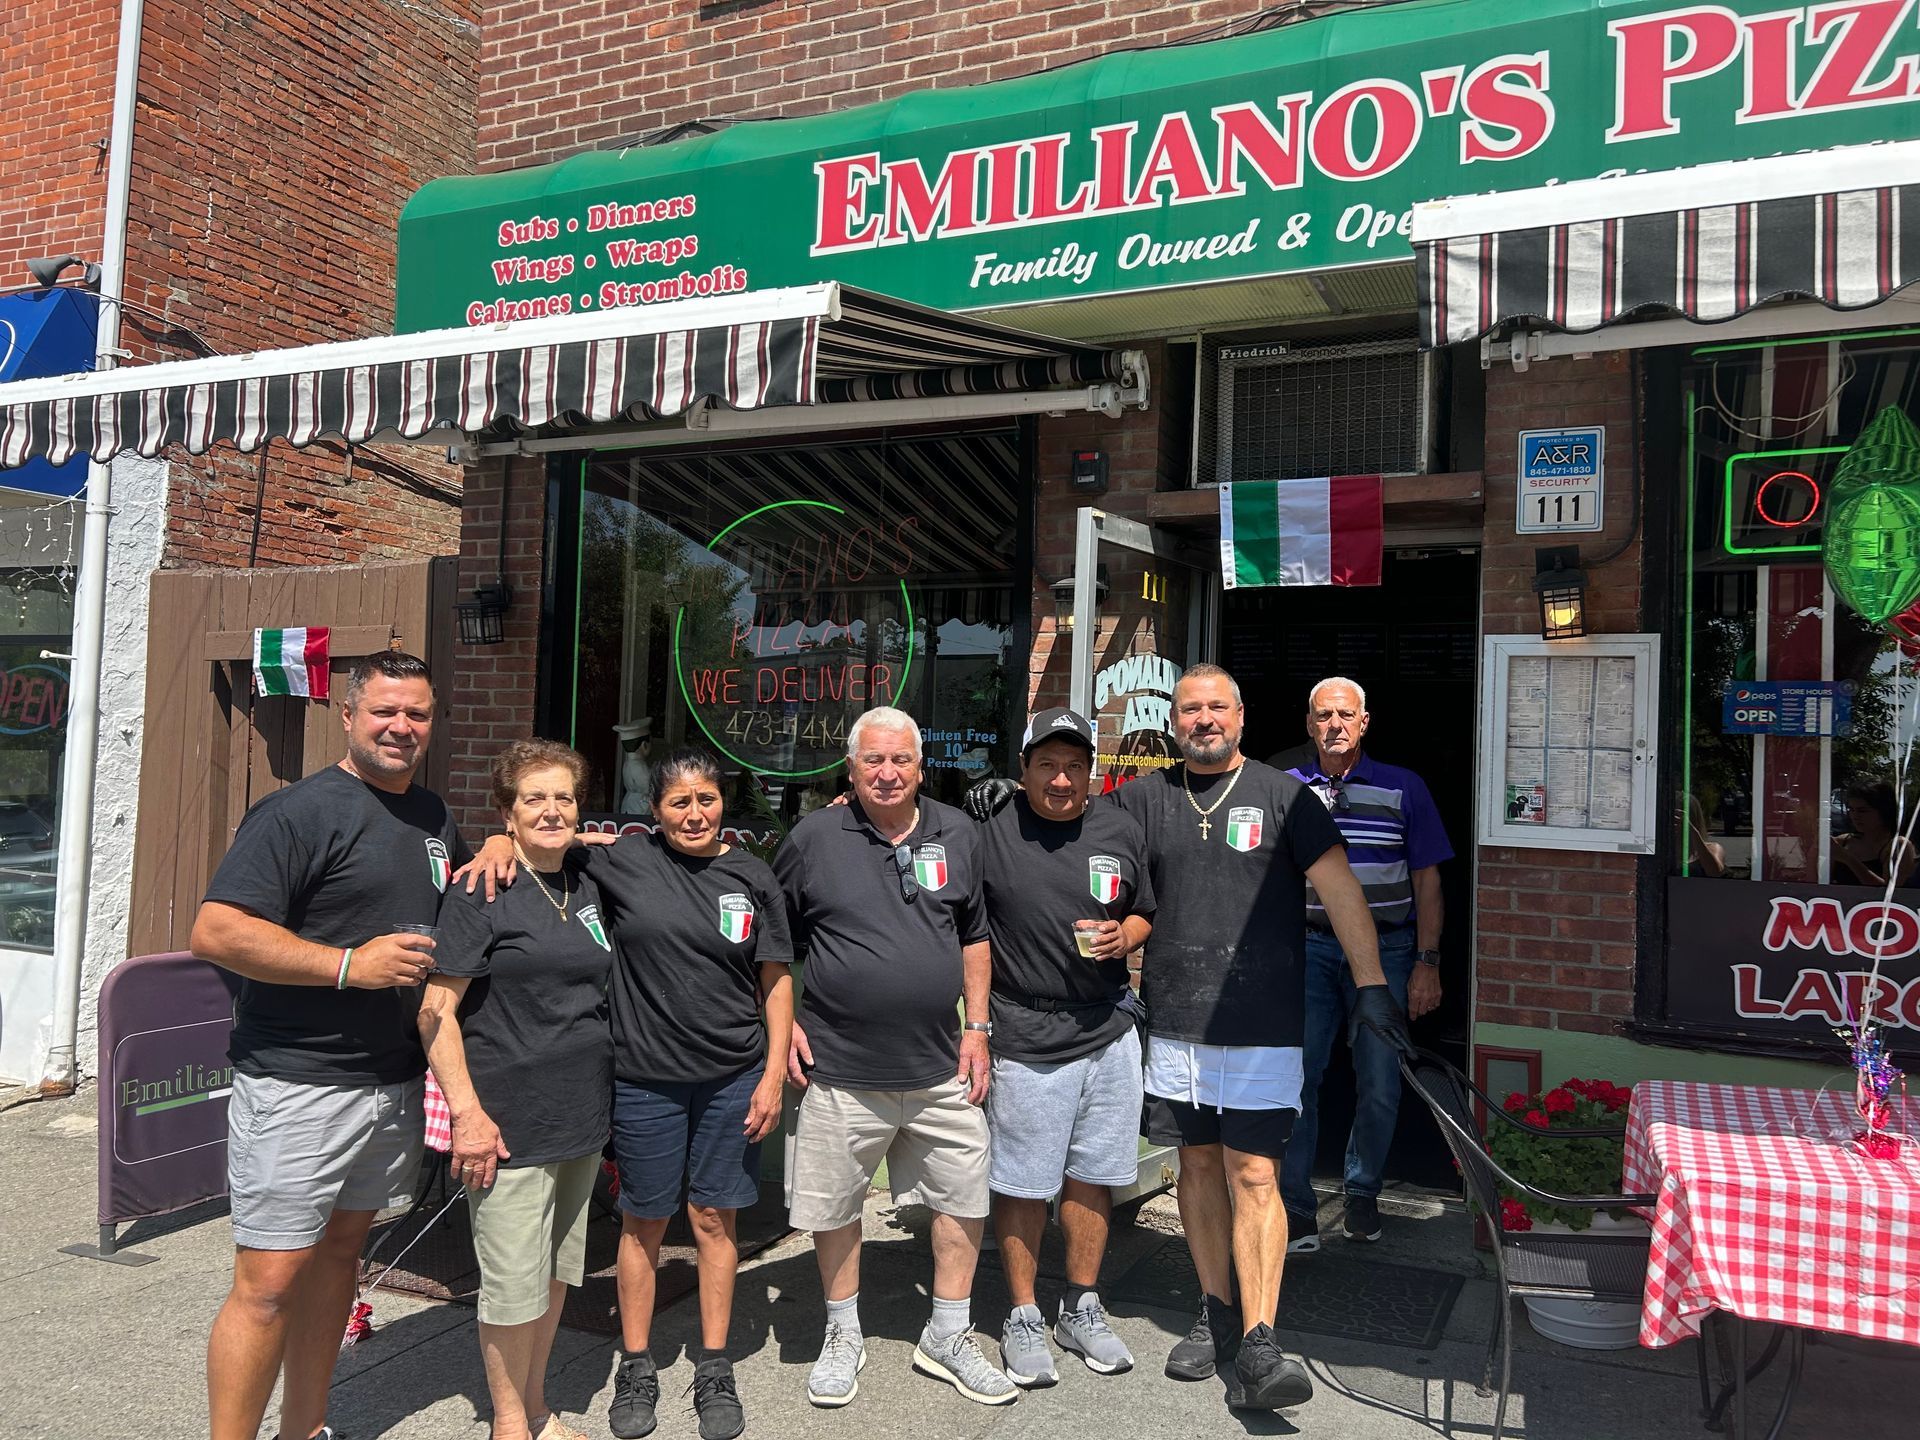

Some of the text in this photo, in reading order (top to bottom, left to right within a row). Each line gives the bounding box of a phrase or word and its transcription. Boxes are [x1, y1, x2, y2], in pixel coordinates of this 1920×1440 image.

[810, 0, 1920, 257] EMILIANO'S PIZ
[499, 194, 696, 247] Subs Dinners
[492, 235, 698, 285] Wings Wraps
[969, 203, 1413, 288] Family Owned & Ope
[466, 268, 747, 327] Calzones Strombolis
[1220, 346, 1287, 360] Friedrich
[1529, 465, 1592, 476] 845-471-1830
[1532, 444, 1590, 466] A&R
[1529, 478, 1591, 488] SECURITY
[1537, 494, 1581, 523] 111
[693, 664, 894, 705] WE DELIVER
[1751, 692, 1777, 701] peps
[966, 728, 997, 744] Free
[1763, 897, 1920, 961] MO
